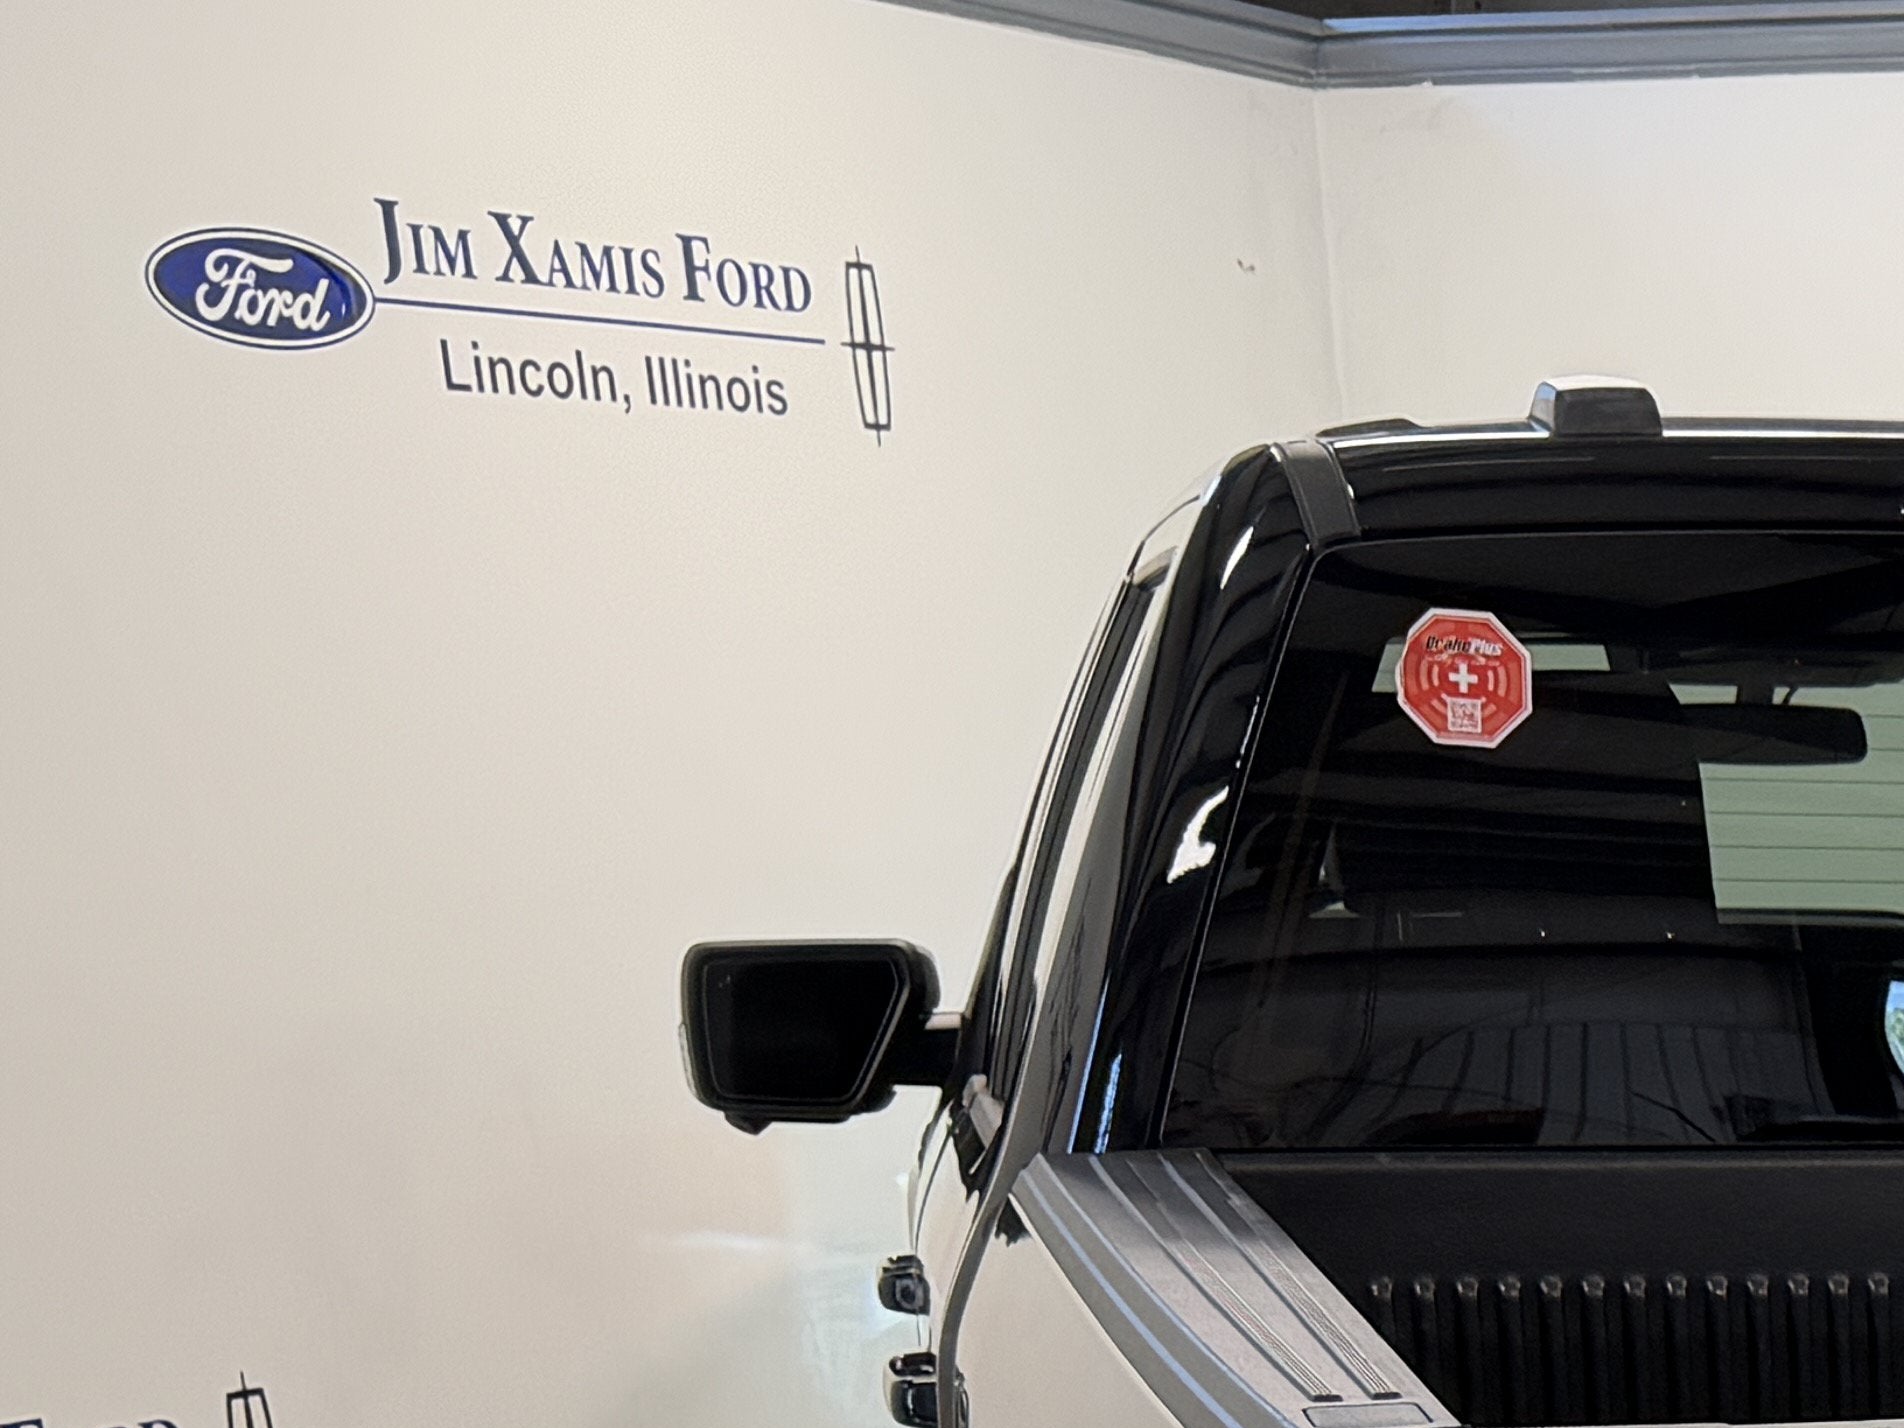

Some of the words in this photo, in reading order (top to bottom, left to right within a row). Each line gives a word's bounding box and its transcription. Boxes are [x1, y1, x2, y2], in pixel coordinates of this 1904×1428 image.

[194, 247, 332, 332] Ford
[373, 197, 477, 286] JIM
[487, 210, 667, 302] XAMIS
[676, 232, 813, 314] FORD
[439, 338, 633, 413] Lincoln,
[644, 354, 790, 417] Illinois
